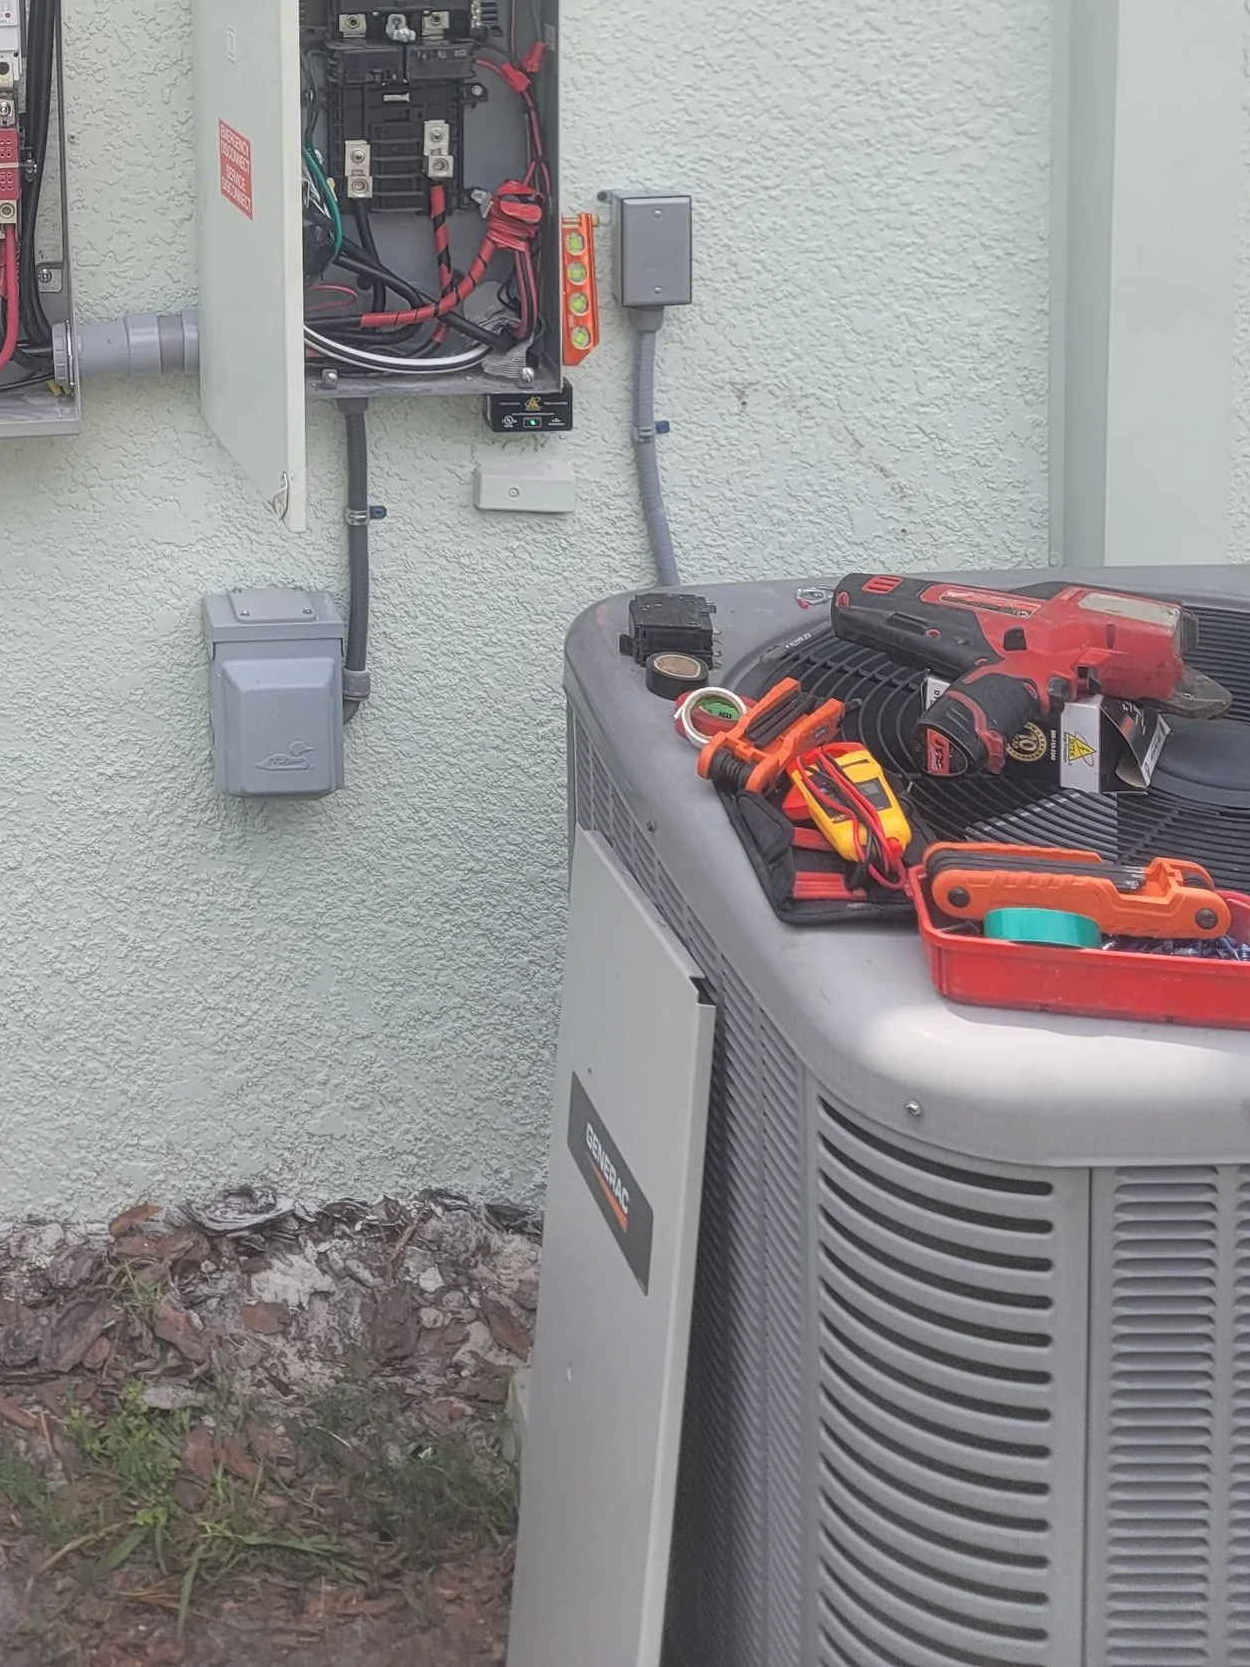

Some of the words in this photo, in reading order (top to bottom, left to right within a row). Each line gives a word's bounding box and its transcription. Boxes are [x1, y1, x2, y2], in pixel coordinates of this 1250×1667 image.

[220, 123, 250, 158] EMERGENCY
[221, 139, 251, 175] DISCONNECT
[222, 175, 252, 212] DISCONNECT
[225, 163, 246, 192] SERVICE
[586, 1122, 629, 1215] GENERAC
